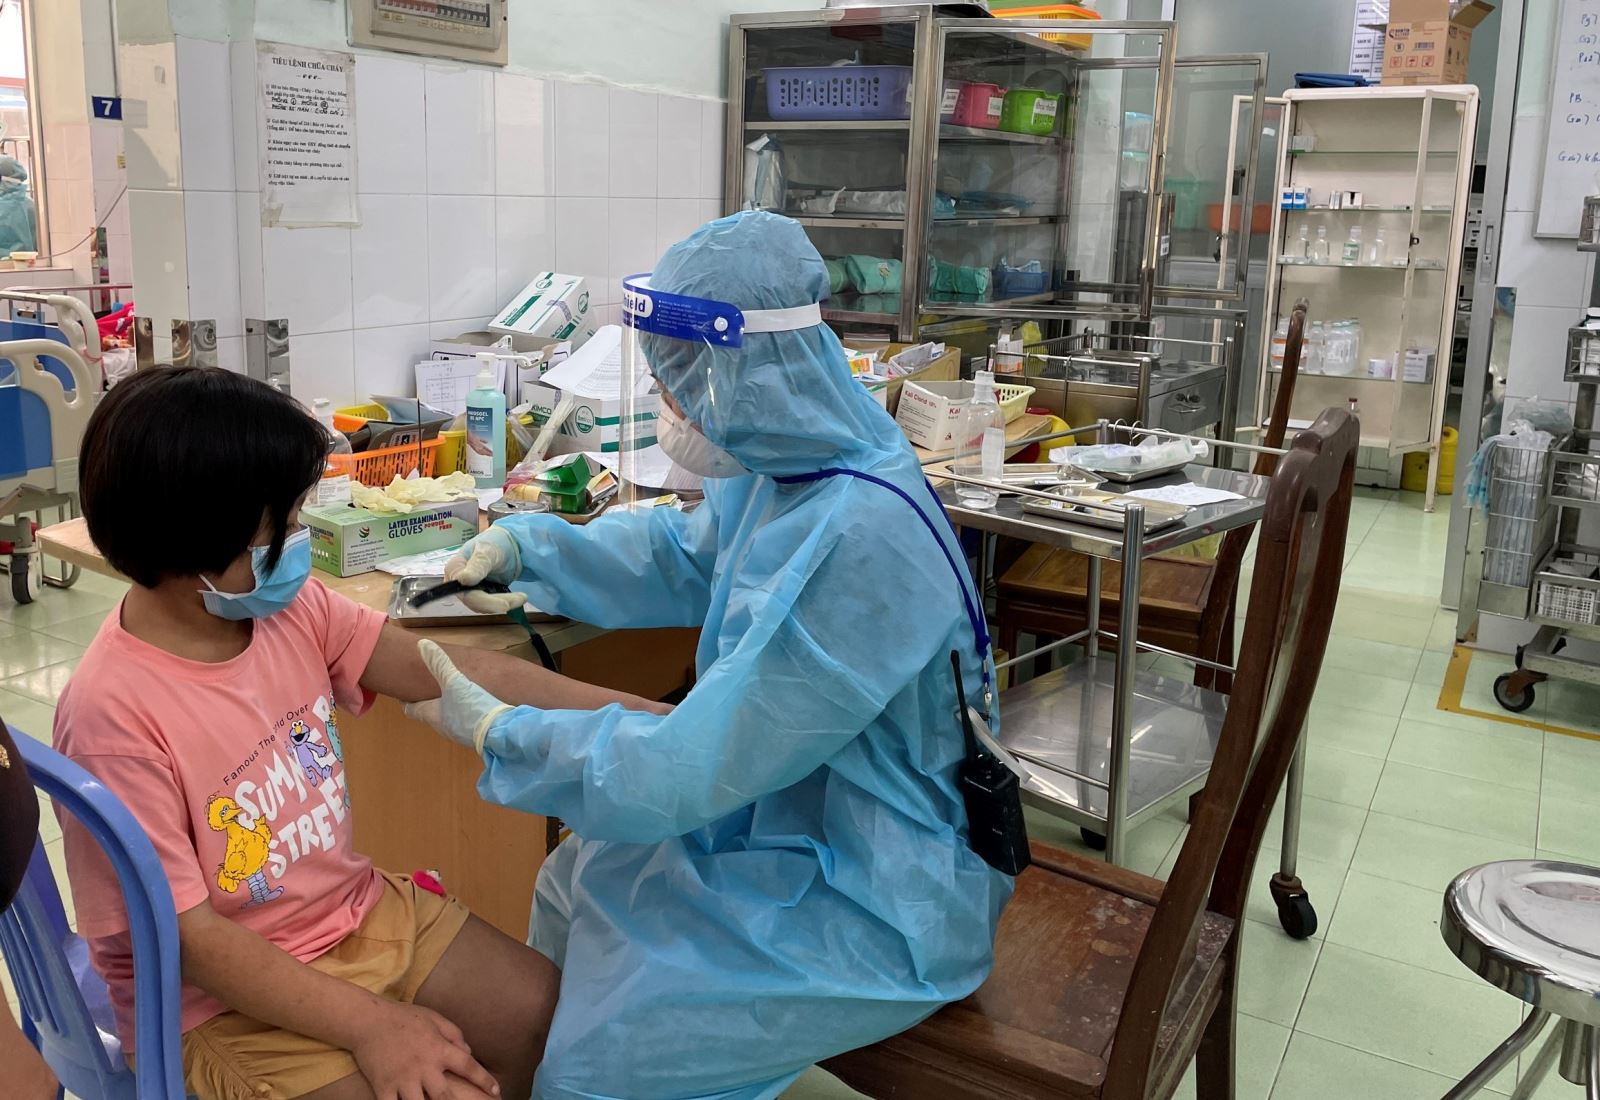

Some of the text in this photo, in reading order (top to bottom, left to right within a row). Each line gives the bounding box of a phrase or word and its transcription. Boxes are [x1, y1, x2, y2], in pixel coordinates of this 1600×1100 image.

[289, 58, 307, 69] LỆNH
[307, 60, 325, 71] CHỮA
[101, 100, 113, 116] 7
[623, 293, 646, 313] hield
[388, 511, 452, 530] LATEX EXAMINATION
[424, 520, 445, 529] POWDER
[388, 523, 423, 539] GLOVES
[223, 750, 259, 786] Famous
[258, 733, 276, 751] The
[286, 704, 308, 721] Over
